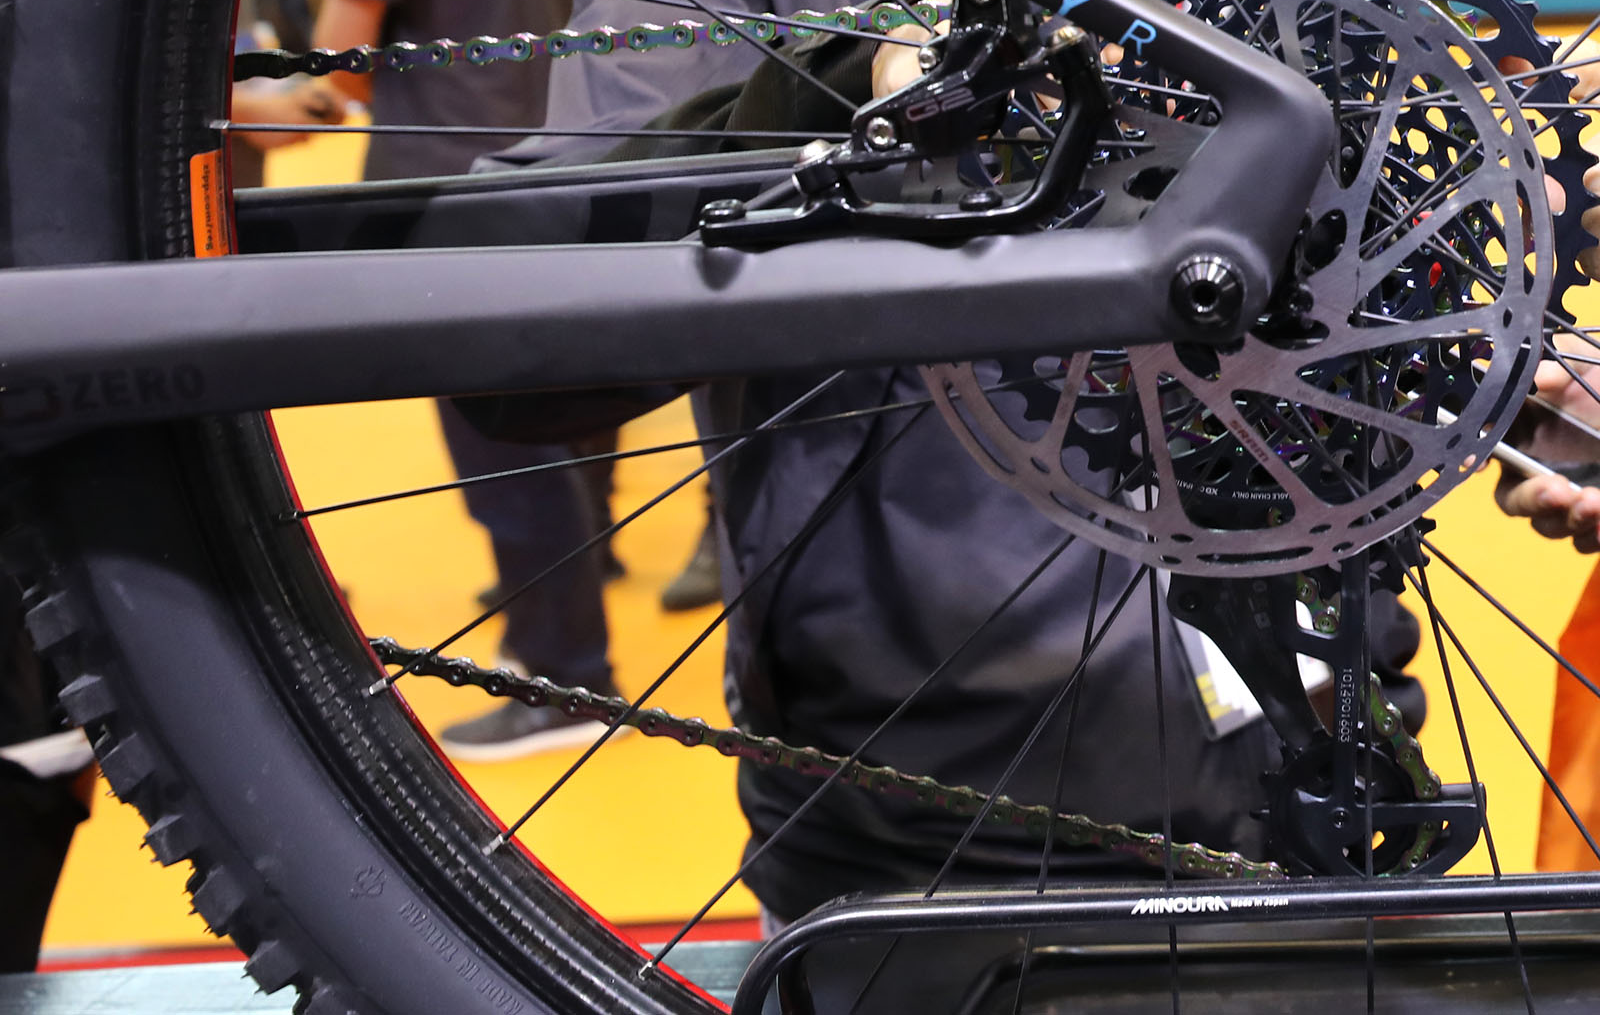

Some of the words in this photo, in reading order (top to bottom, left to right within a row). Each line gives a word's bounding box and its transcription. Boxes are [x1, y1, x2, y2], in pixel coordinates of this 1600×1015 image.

[906, 87, 976, 121] G2
[64, 363, 205, 412] ZERO
[1271, 491, 1290, 500] AGLE
[1131, 895, 1229, 915] MINOURA
[1231, 898, 1253, 908] Made
[1264, 897, 1289, 908] Japan
